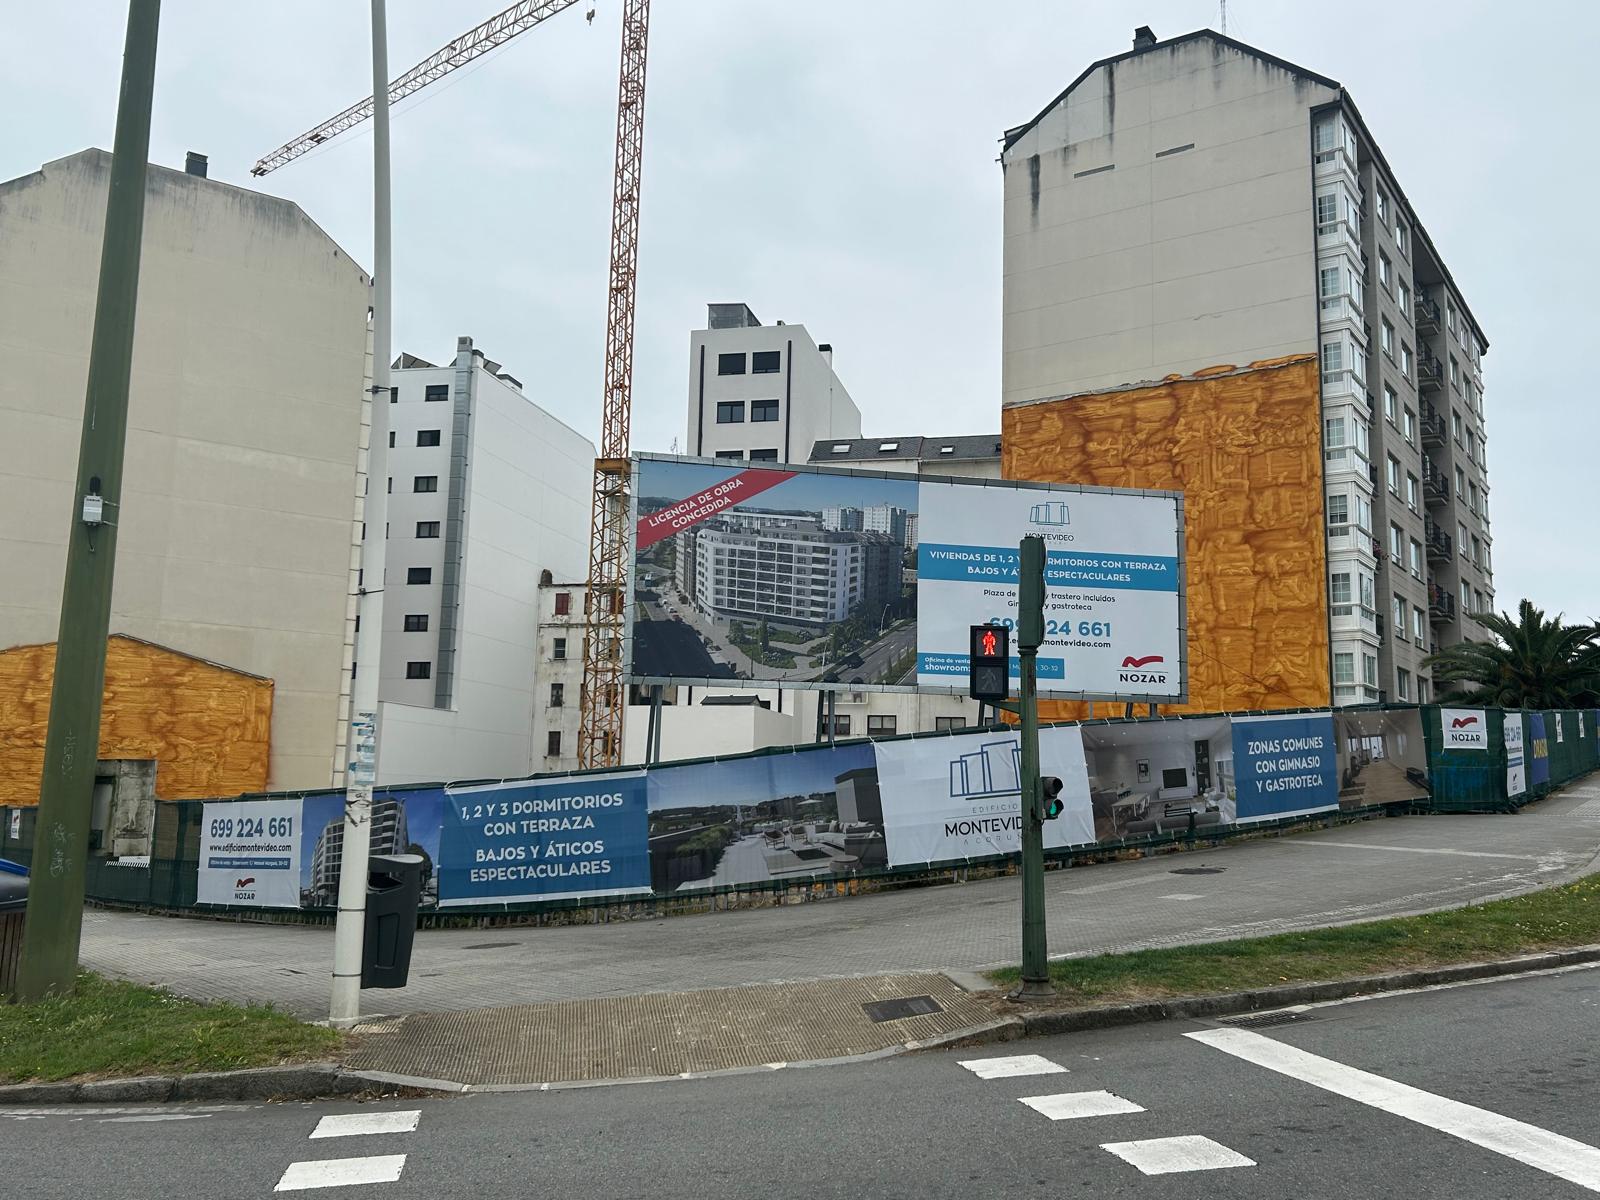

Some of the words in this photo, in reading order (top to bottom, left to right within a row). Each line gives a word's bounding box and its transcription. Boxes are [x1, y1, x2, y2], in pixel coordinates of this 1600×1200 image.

[648, 501, 697, 527] LICENCIA
[697, 493, 713, 506] DE
[714, 478, 744, 497] OBRA
[672, 496, 732, 528] CONCEDIDA
[930, 551, 981, 561] VIVIENDAS
[999, 555, 1005, 563] 1,
[1047, 558, 1098, 569] RMITORIOS
[1101, 560, 1121, 570] CON
[1123, 561, 1167, 571] TERRAZA
[968, 566, 999, 575] BAJOS
[1047, 570, 1131, 582] ESPECTACULARES
[984, 589, 1004, 597] Plaza
[1051, 603, 1092, 611] gastroteca
[1047, 620, 1071, 635] 24
[1078, 621, 1111, 637] 661
[1119, 673, 1166, 684] NOZAR
[1248, 741, 1280, 755] ZONAS
[1282, 736, 1323, 751] COMUNES
[1451, 733, 1481, 742] NOZAR
[1255, 760, 1276, 774] CON
[1278, 756, 1320, 771] GIMNASIO
[1256, 780, 1265, 793] Y
[1266, 774, 1323, 791] GASTROTECA
[461, 806, 470, 821] 1,
[473, 805, 482, 818] 2
[486, 803, 495, 817] Y
[499, 802, 508, 815] 3
[513, 793, 624, 815] DORMITORIOS
[972, 803, 1018, 814] EDIFICIO
[211, 818, 233, 838] 699
[237, 818, 263, 838] 224
[268, 817, 293, 837] 661
[484, 821, 516, 836] CON
[521, 815, 595, 834] TERRAZA
[945, 816, 1023, 837] MONTEVID
[209, 843, 292, 854] www.edificiomontevideo.com
[476, 846, 525, 862] BAJOS
[530, 845, 540, 858] Y
[545, 840, 604, 857] ÁTICOS
[470, 860, 611, 882] ESPECTACULARES
